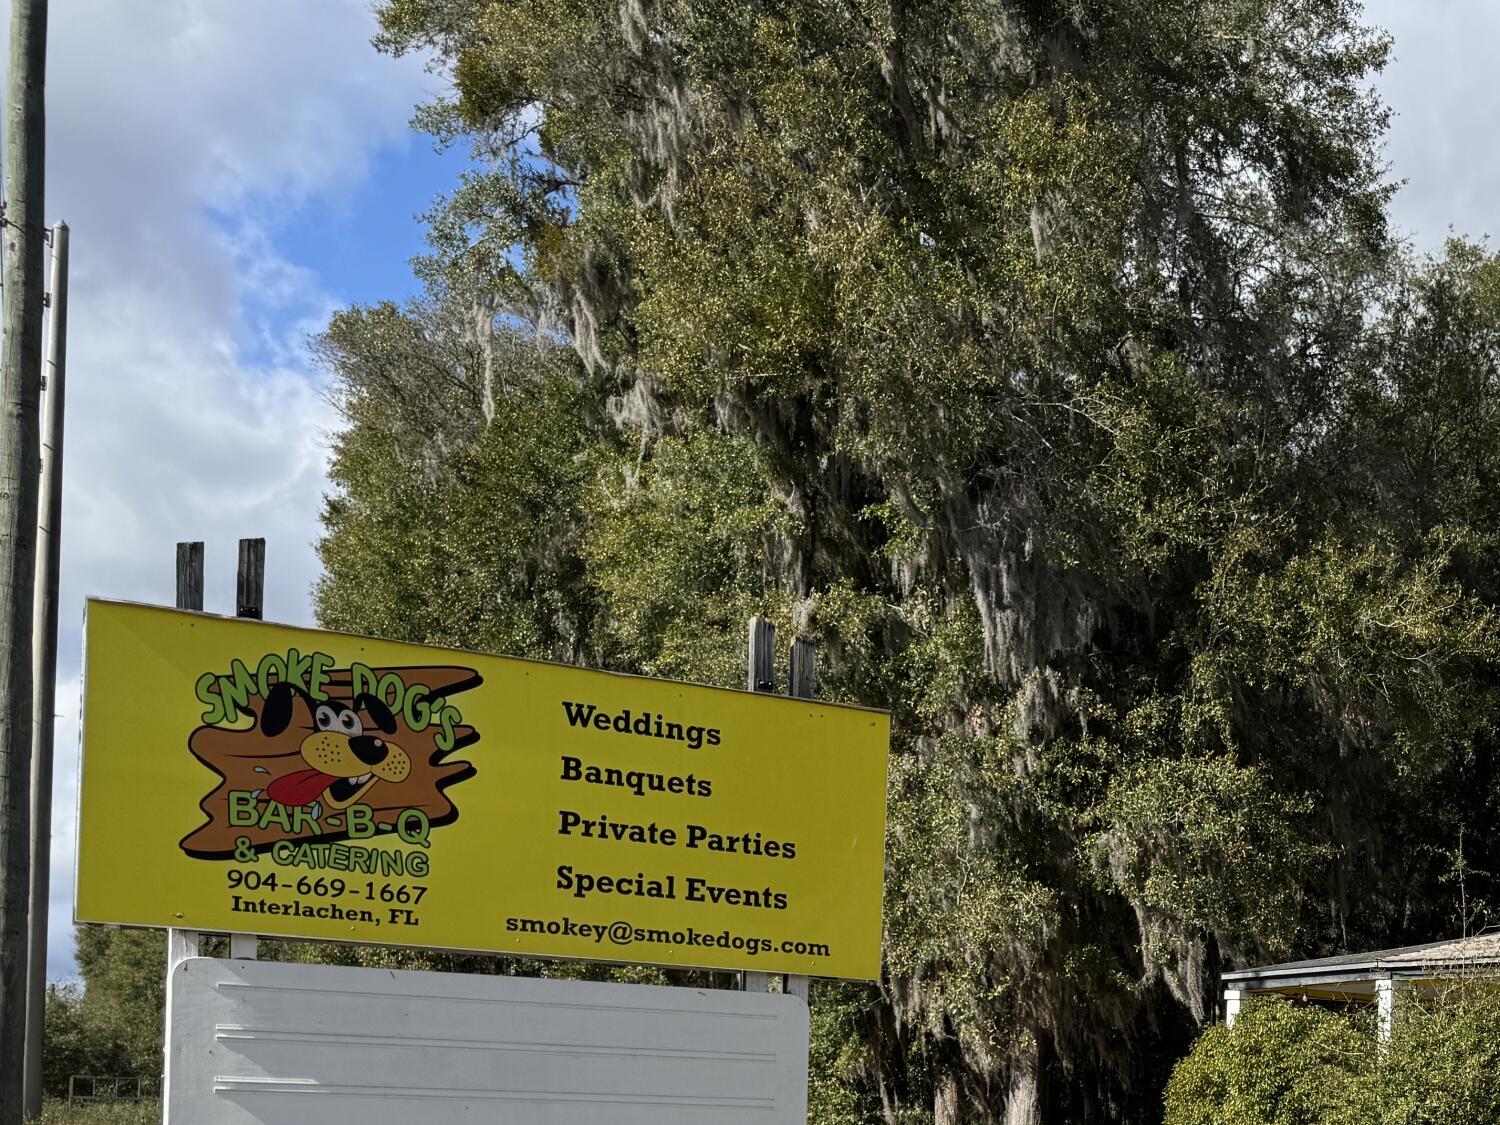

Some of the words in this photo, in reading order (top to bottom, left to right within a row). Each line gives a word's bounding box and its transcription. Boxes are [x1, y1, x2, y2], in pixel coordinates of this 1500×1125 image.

[195, 648, 335, 725] SMOKE
[351, 662, 462, 751] DOG'S
[562, 701, 722, 750] Weddings
[560, 756, 712, 797] Banquets
[228, 790, 431, 849] BAR-B-Q
[558, 810, 677, 846] Private
[686, 824, 797, 860] Parties
[233, 836, 259, 863] &
[271, 840, 430, 878] CATERING
[227, 869, 428, 905] 904-669-1667
[556, 865, 676, 898] Special
[685, 877, 788, 910] Events
[231, 895, 381, 926] Interlachen,
[388, 908, 419, 926] FL
[505, 916, 831, 958] smokey@smokedogs.com
